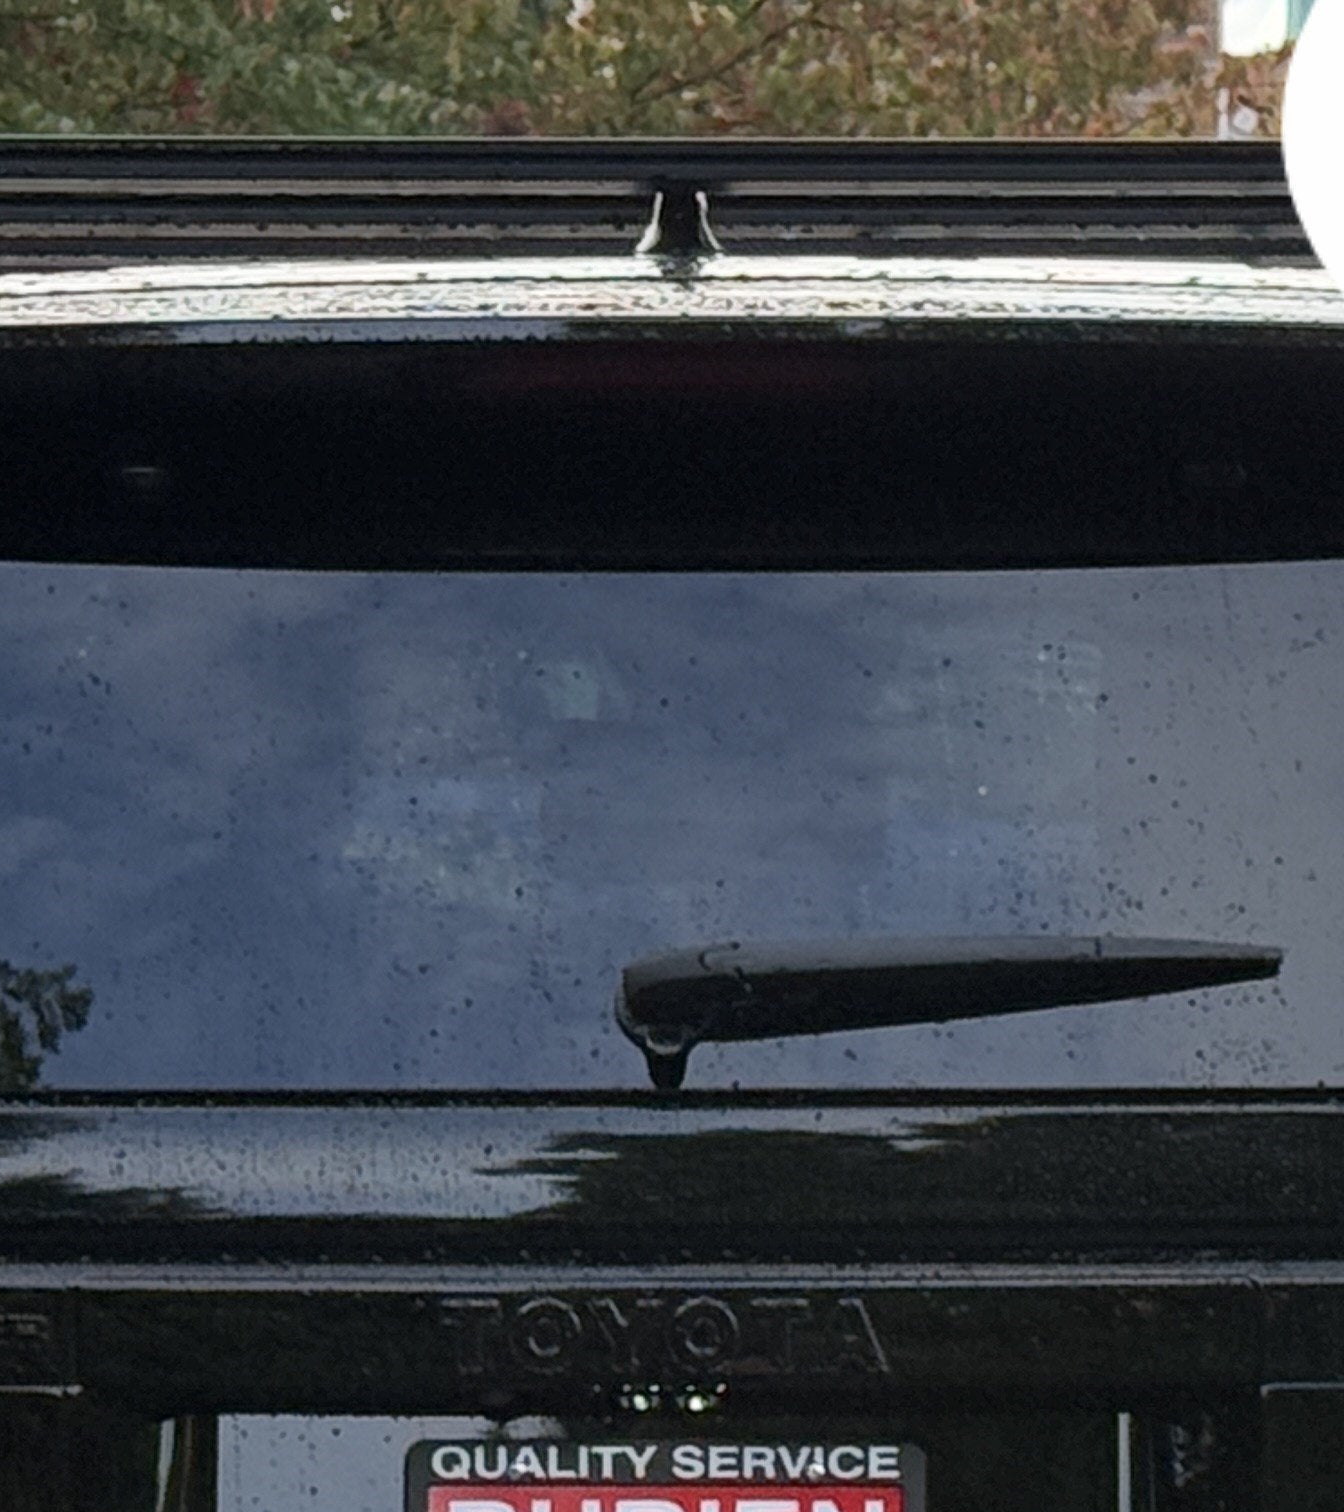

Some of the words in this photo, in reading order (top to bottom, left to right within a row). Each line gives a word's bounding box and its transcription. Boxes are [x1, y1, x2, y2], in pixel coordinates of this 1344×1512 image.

[440, 1296, 892, 1374] TOYOTA
[430, 1444, 657, 1481] QUALITY
[671, 1443, 901, 1481] SERVICE
